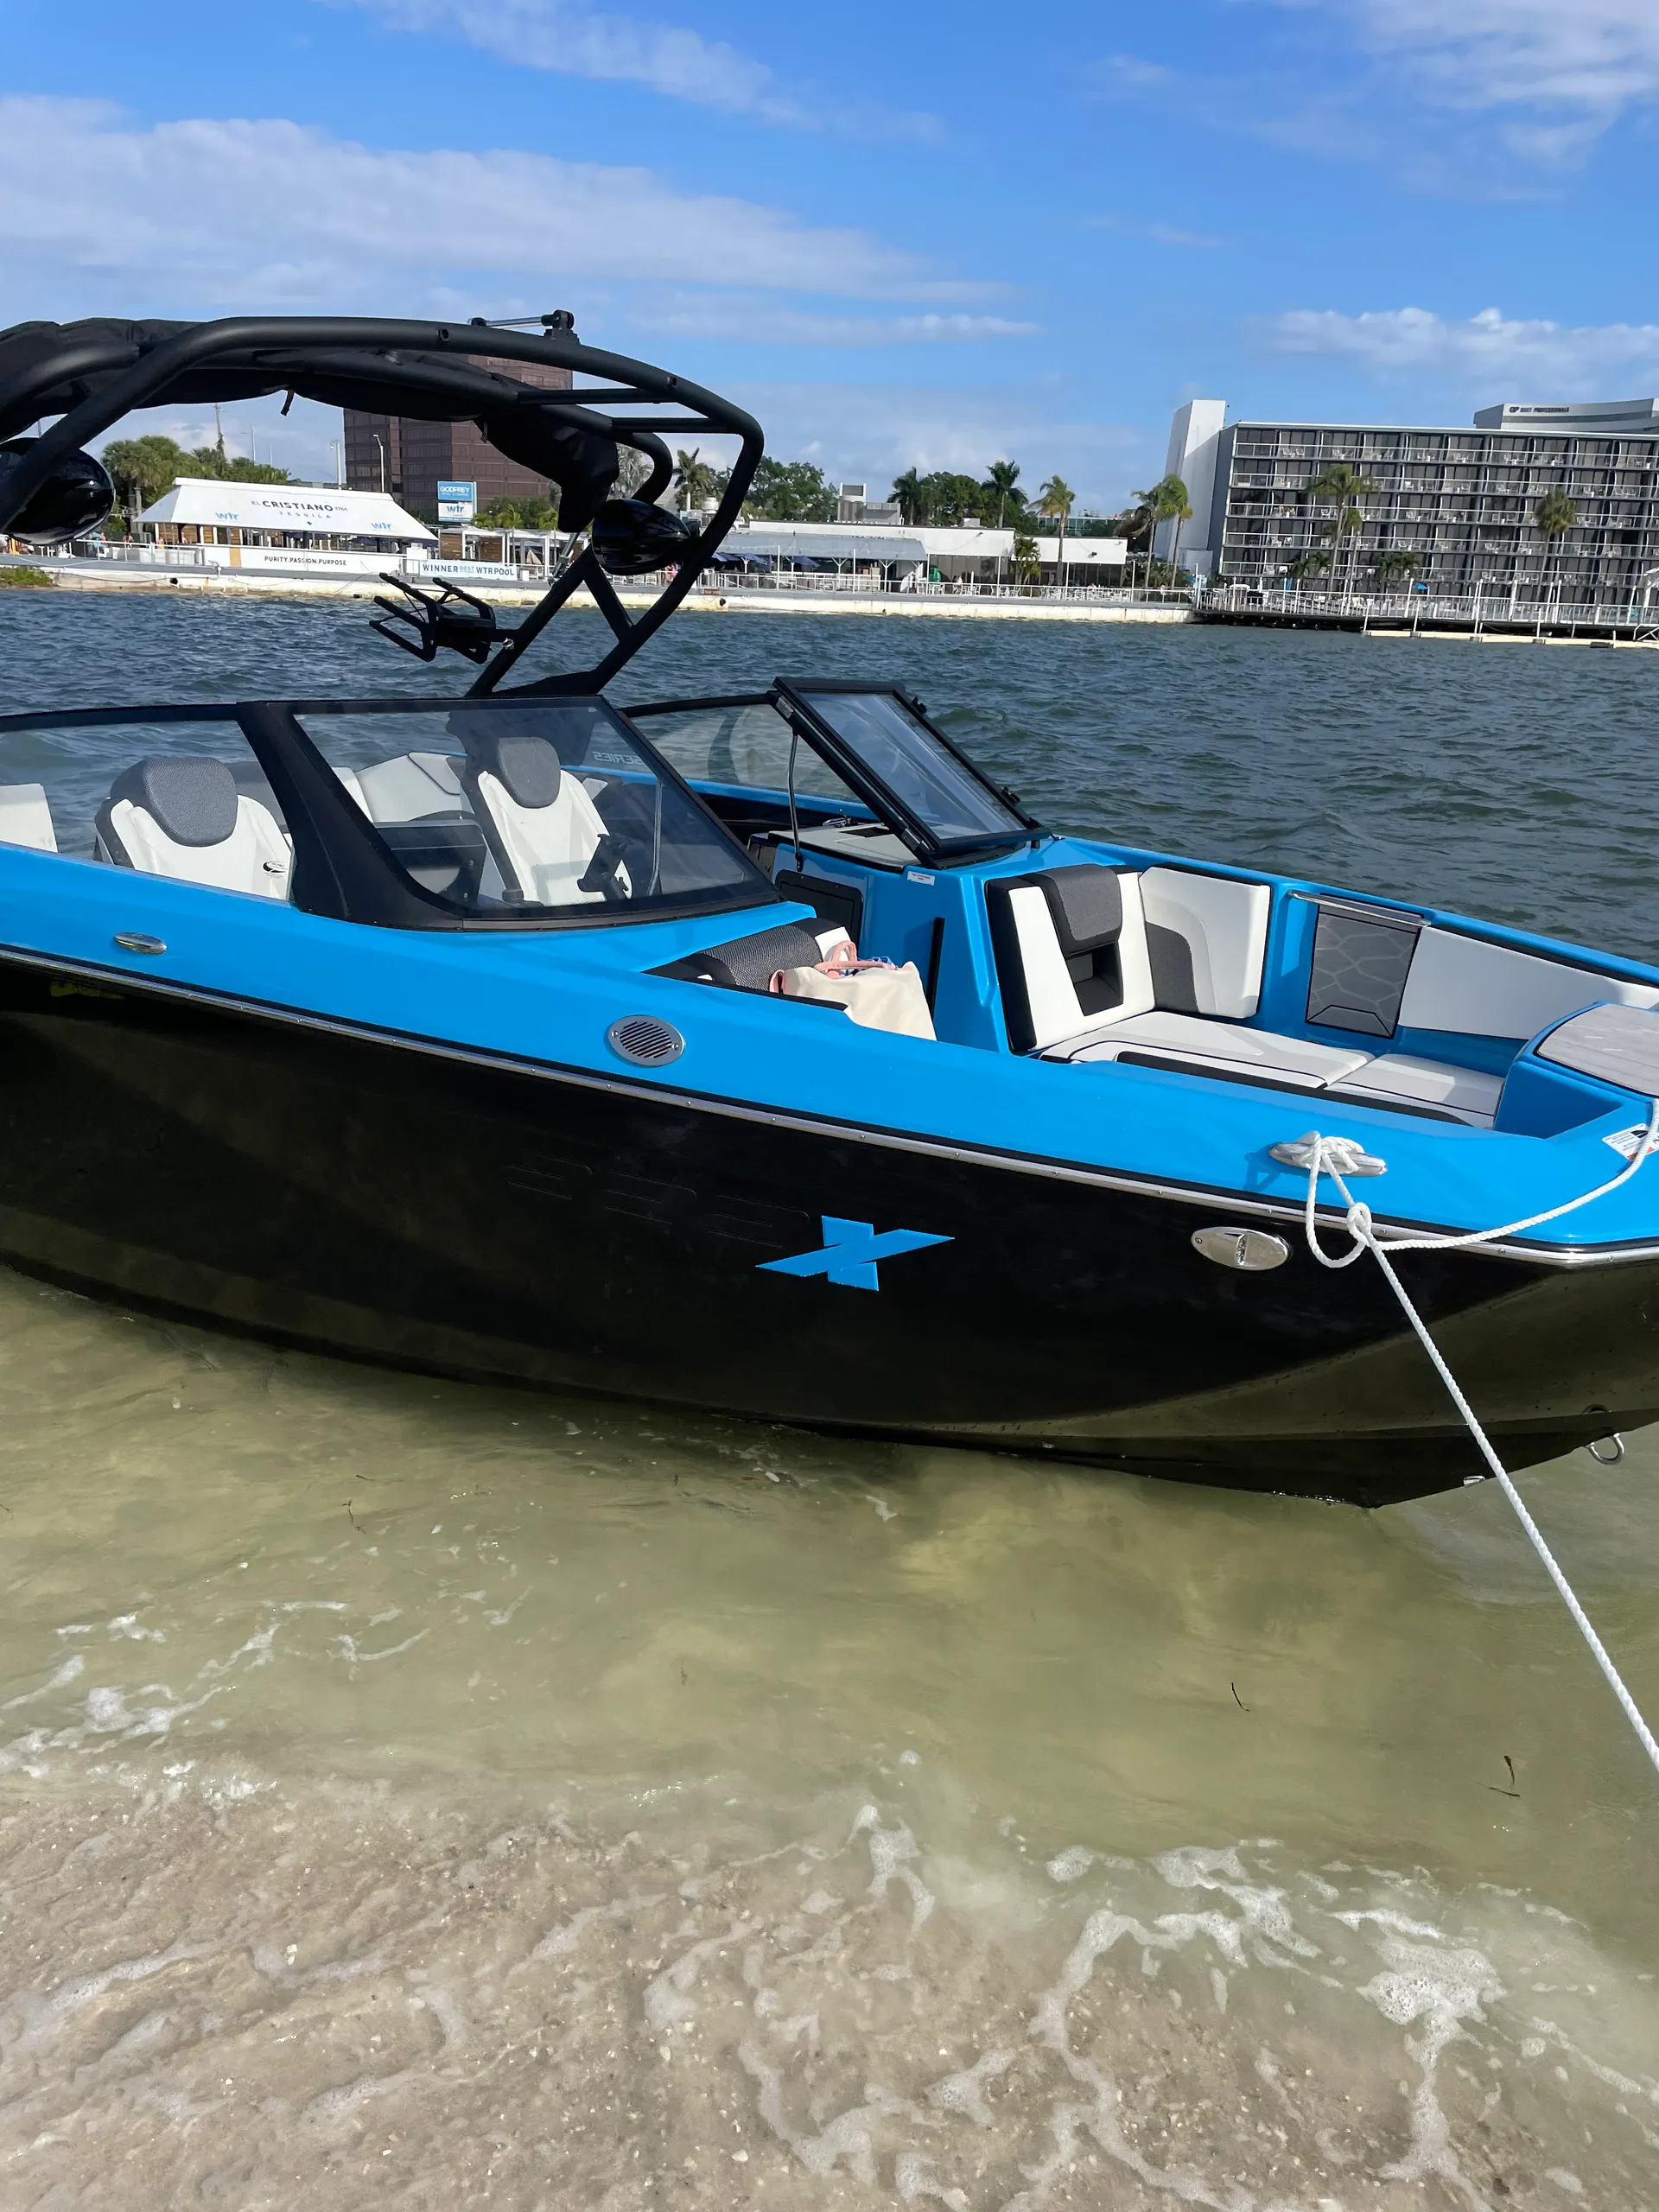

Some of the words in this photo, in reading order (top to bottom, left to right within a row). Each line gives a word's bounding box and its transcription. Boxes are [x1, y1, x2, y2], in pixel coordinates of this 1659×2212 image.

[262, 500, 334, 512] CRISTIANO
[447, 504, 465, 513] wtr
[423, 563, 459, 573] WINNER
